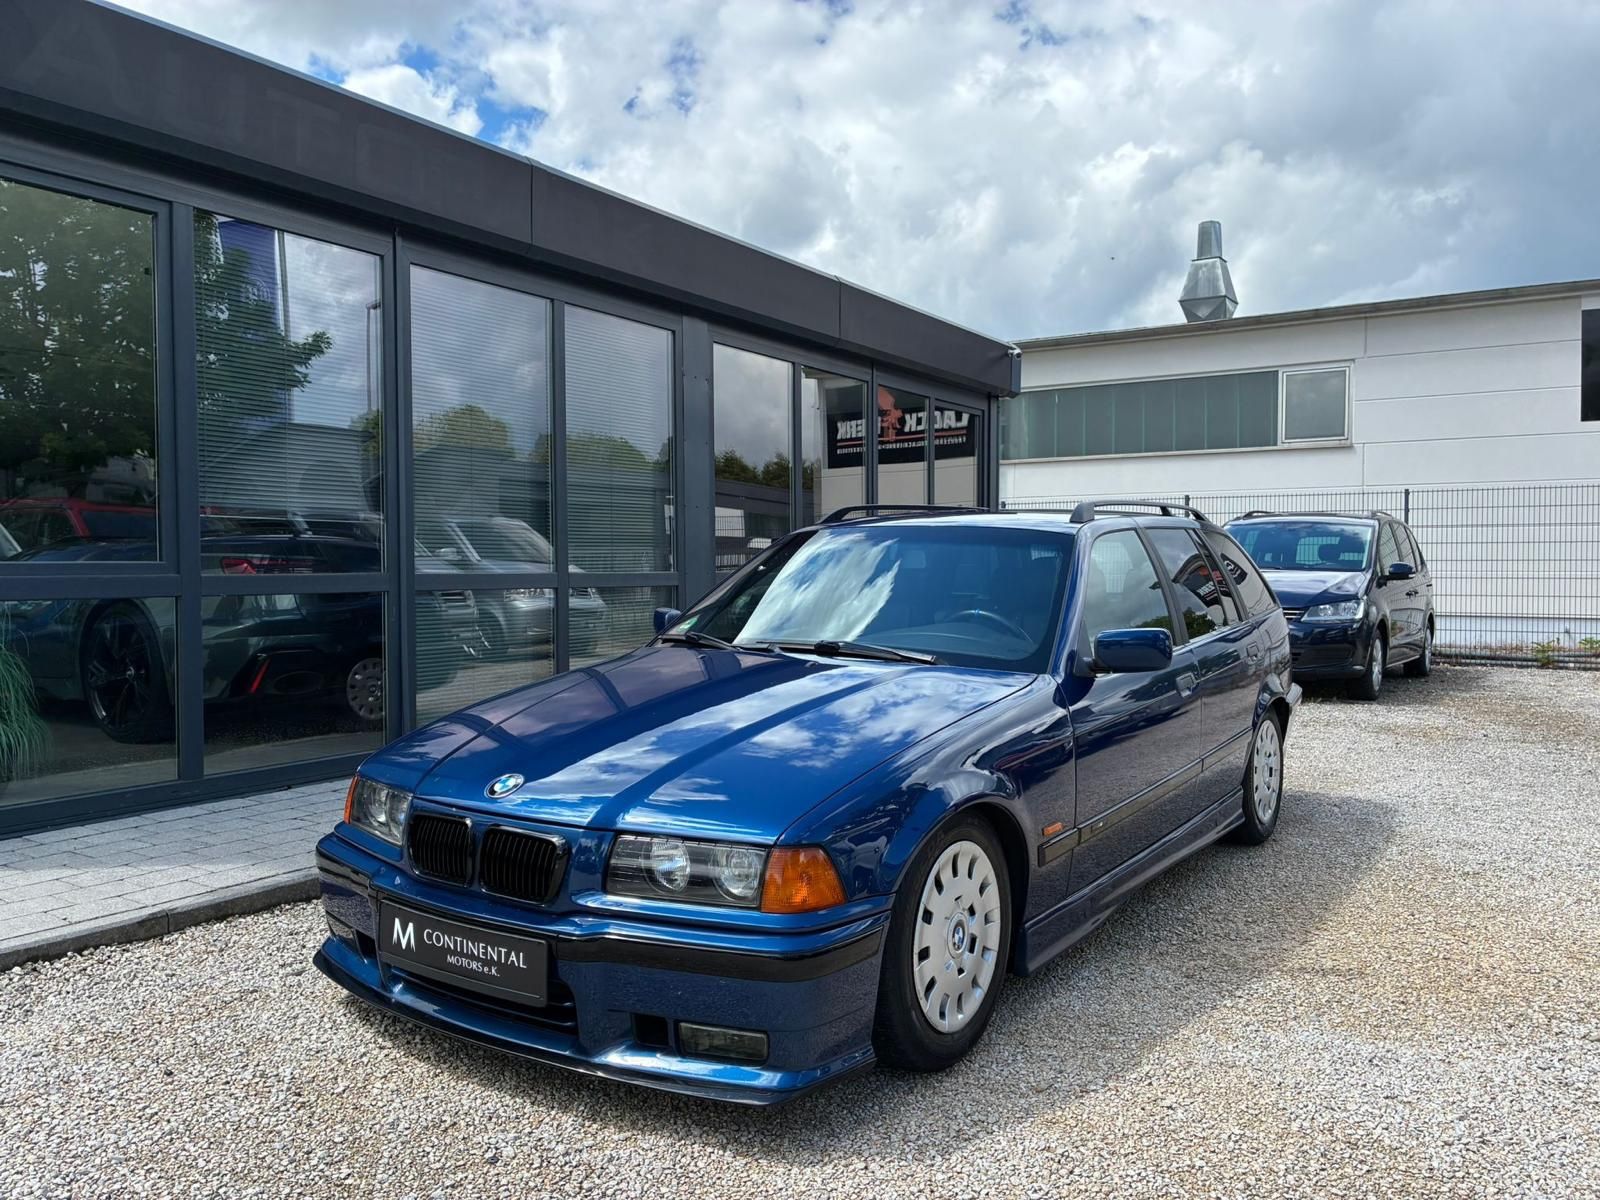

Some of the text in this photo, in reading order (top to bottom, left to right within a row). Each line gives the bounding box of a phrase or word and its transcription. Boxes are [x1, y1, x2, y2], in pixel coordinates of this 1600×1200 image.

[423, 928, 527, 969] CONTINENTAL
[446, 954, 500, 977] MOTORS e.K.
